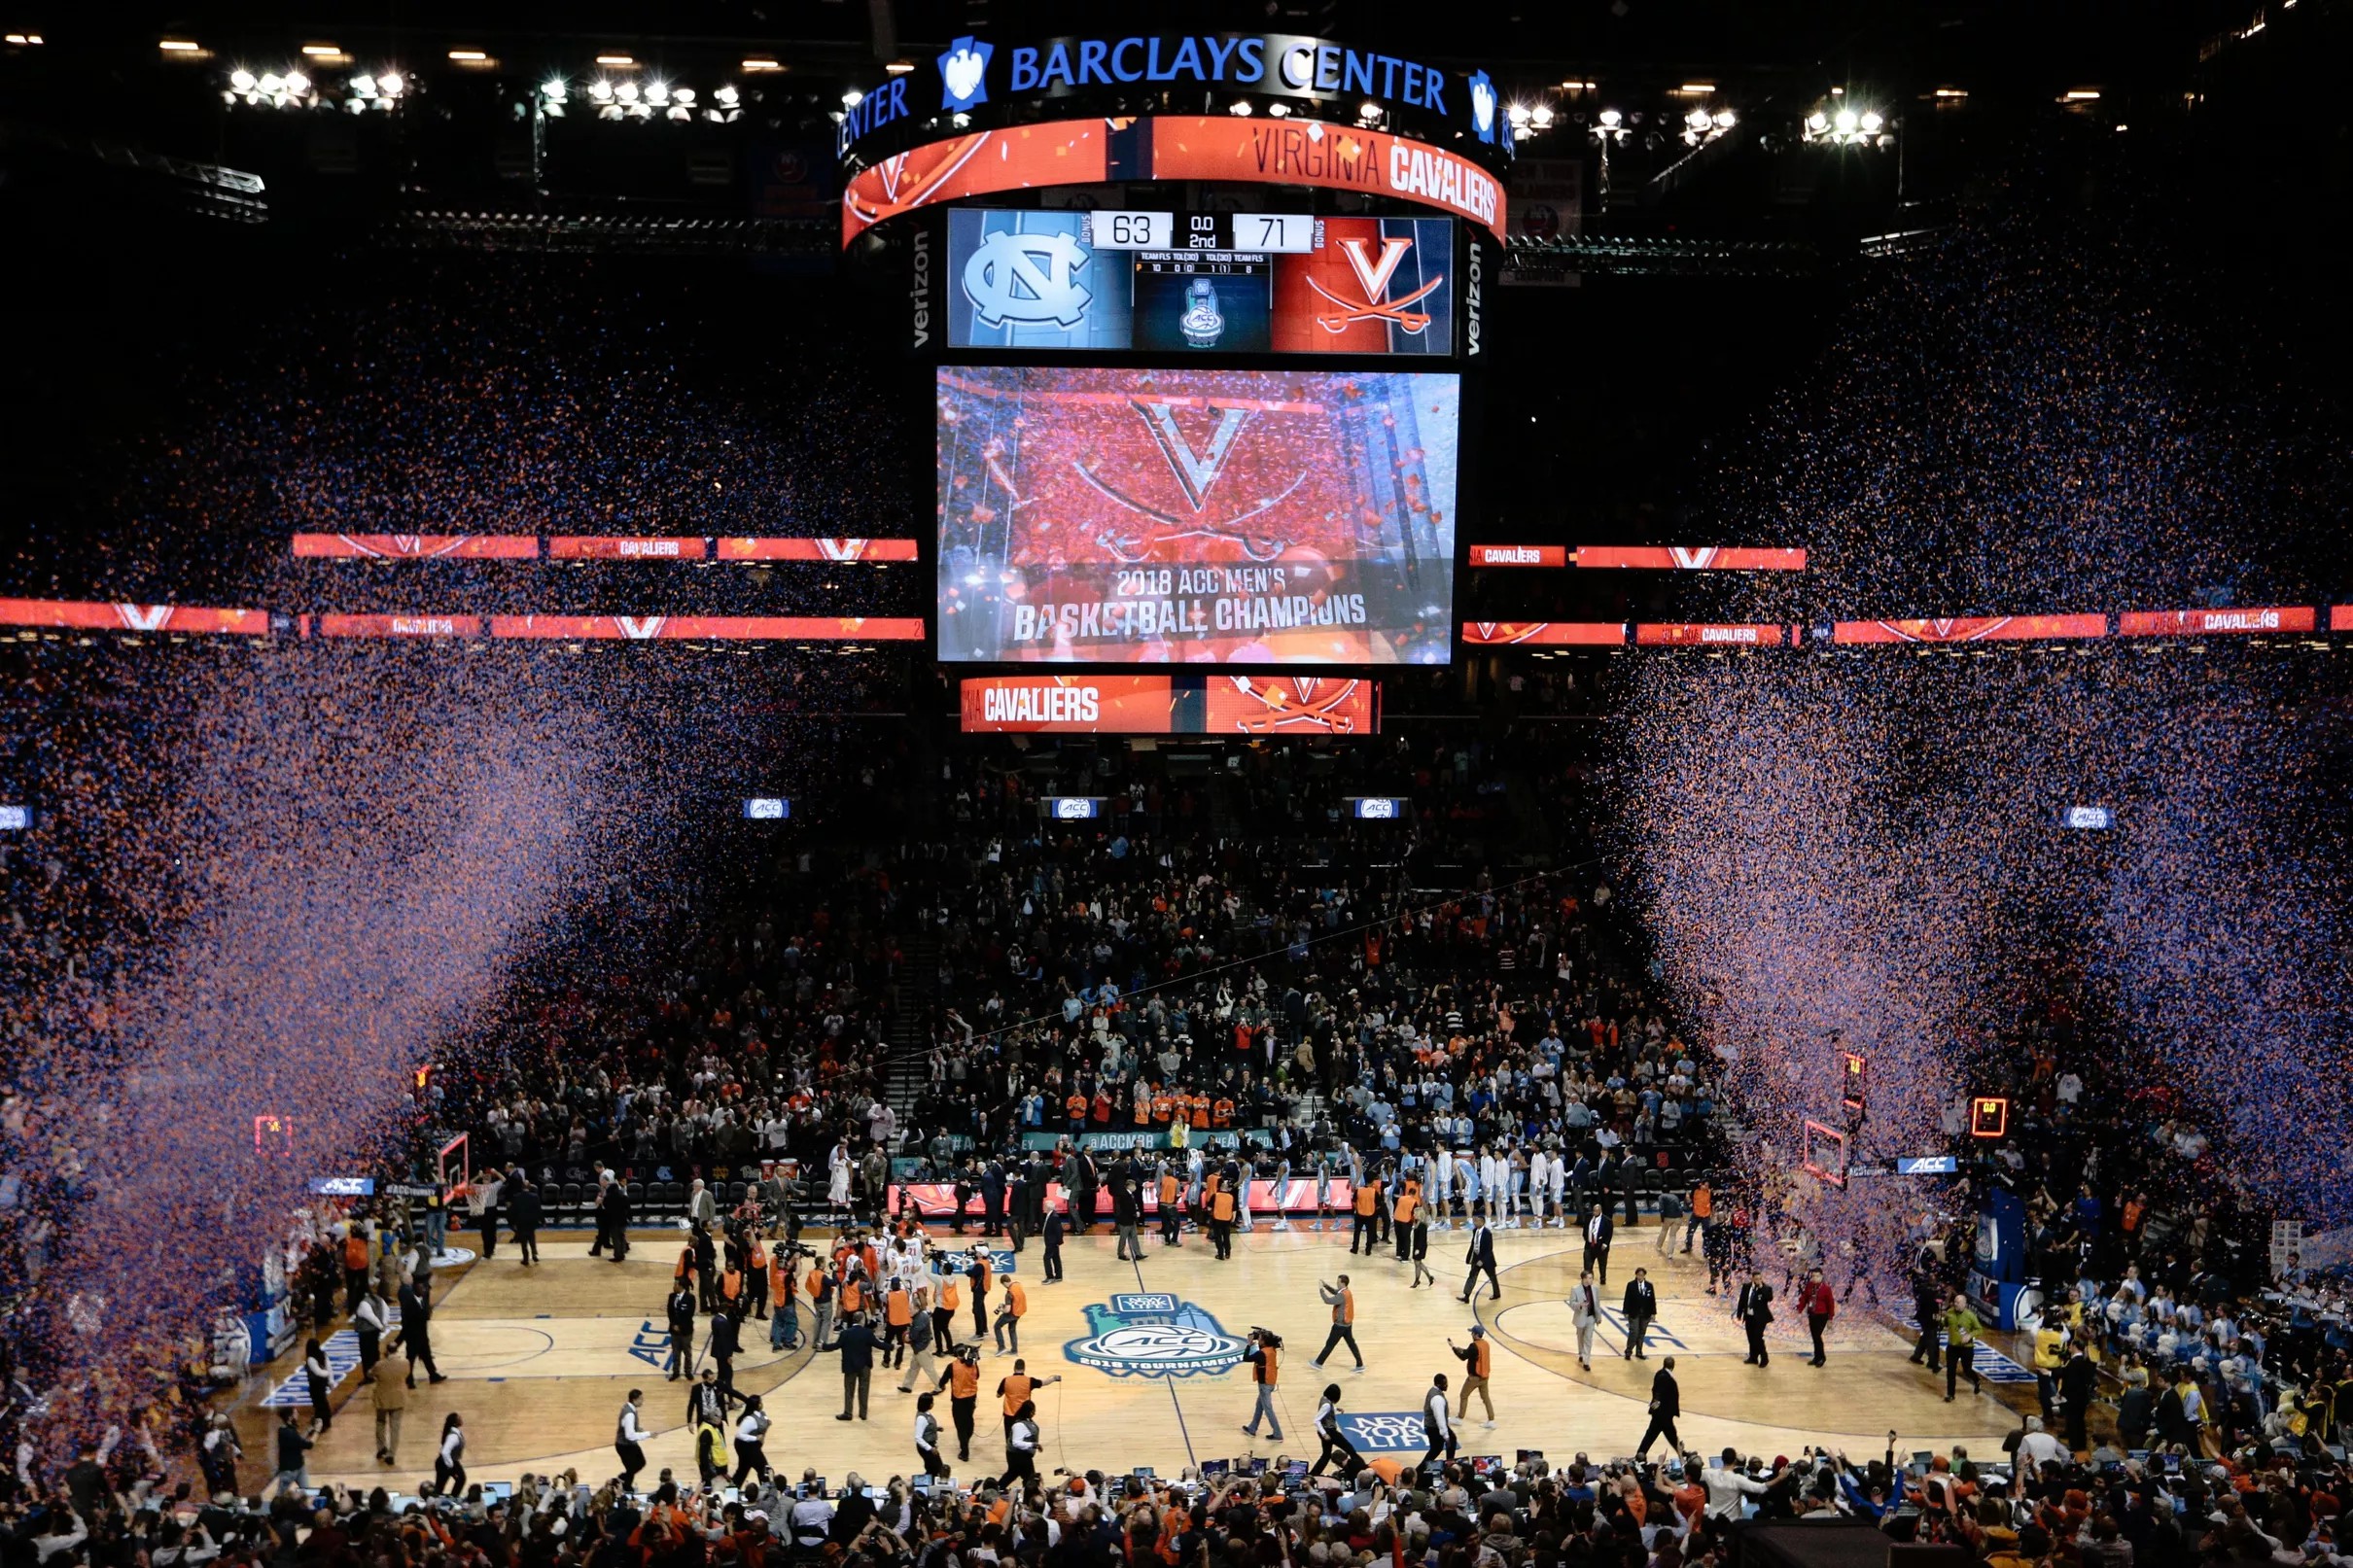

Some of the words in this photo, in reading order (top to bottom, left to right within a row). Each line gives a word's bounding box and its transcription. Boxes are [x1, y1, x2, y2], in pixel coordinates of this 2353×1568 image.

[1011, 37, 1264, 91] BARCLAYS
[1282, 42, 1447, 116] CENTER
[1253, 127, 1381, 185] VIRGINIA
[1389, 144, 1497, 226] CAVALIERS
[1081, 214, 1091, 243] BONUS
[1113, 215, 1151, 245] 63
[1190, 216, 1214, 231] 0.0
[1258, 218, 1284, 247] 71
[1314, 220, 1325, 249] BONUS
[1189, 234, 1216, 249] 2nd
[1234, 254, 1251, 262] TEAM
[1152, 263, 1161, 272] 10
[910, 231, 930, 348] verizon
[1465, 243, 1482, 356] verizon
[619, 540, 679, 556] CAVALIERS
[1484, 548, 1541, 563] CAVALIERS
[1117, 569, 1172, 596] 2018
[1177, 569, 1219, 595] ACC
[1226, 568, 1285, 593] MEN'S
[1013, 599, 1211, 642] BASKETBALL
[1215, 594, 1366, 631] CHAMPIONS
[2204, 610, 2279, 631] CAVALIERS
[1702, 626, 1757, 643] CAVALIERS
[984, 686, 1099, 721] CAVALIERS
[754, 803, 779, 813] ACC
[1063, 803, 1088, 813] ACC
[1906, 1156, 1949, 1173] ACC
[1117, 1336, 1209, 1346] ACC
[1080, 1357, 1123, 1369] 2018
[1129, 1354, 1245, 1370] TOURNAMENT
[1354, 1416, 1425, 1429] NEW
[1345, 1425, 1429, 1444] YOR
[1364, 1435, 1429, 1448] LIF
